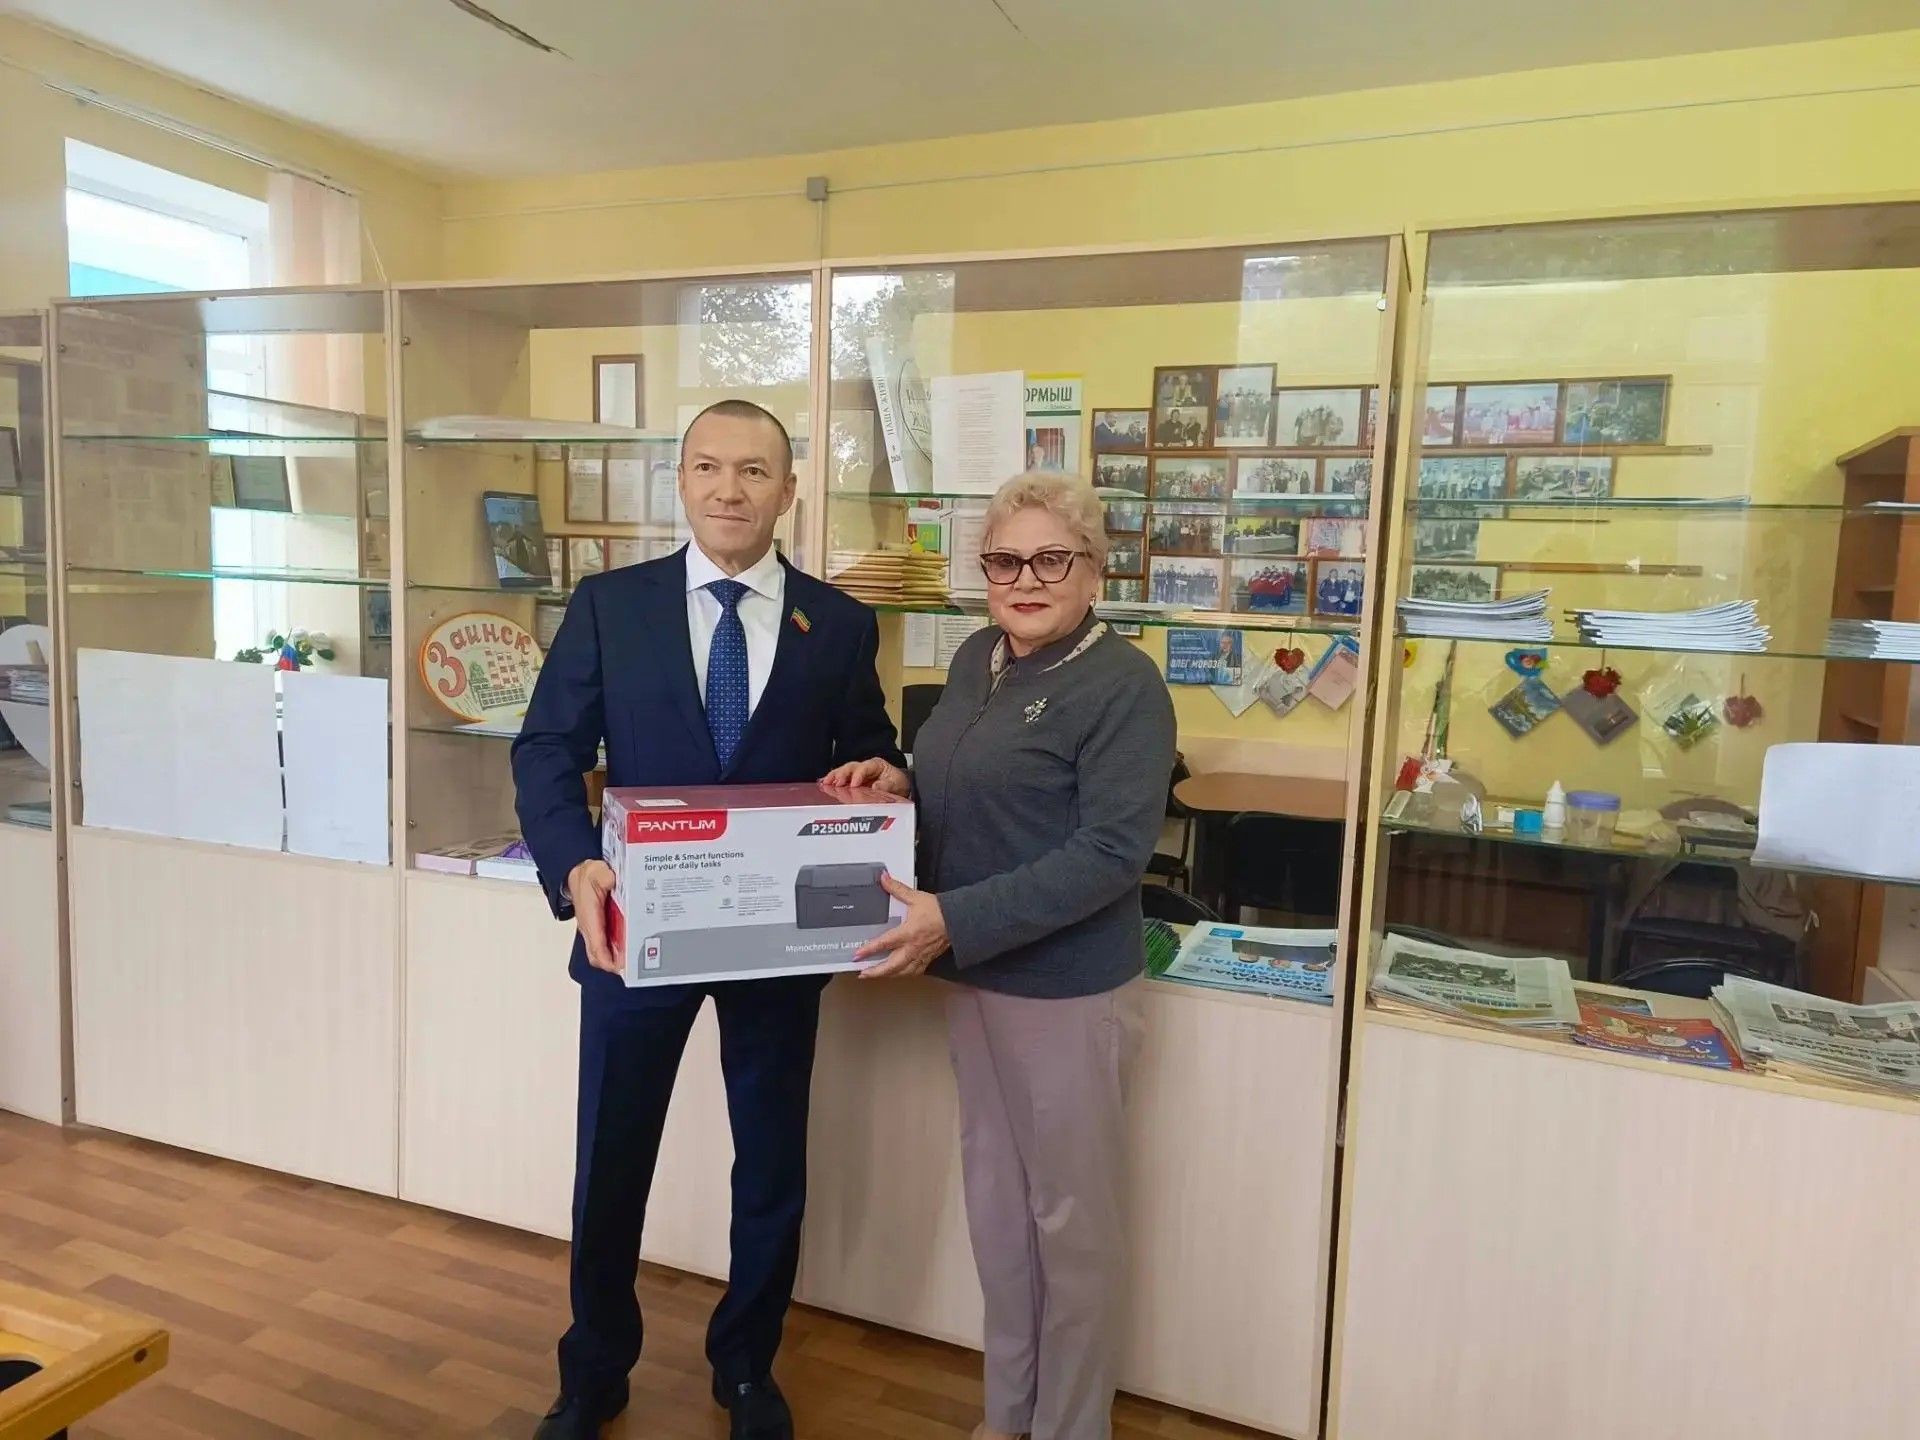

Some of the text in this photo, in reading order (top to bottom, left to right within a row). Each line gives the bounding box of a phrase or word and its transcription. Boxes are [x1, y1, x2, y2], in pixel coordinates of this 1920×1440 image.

[637, 819, 716, 832] PANTUM
[811, 821, 871, 834] P2500NW
[644, 854, 673, 864] Simple
[682, 853, 706, 861] Smart
[708, 850, 745, 860] functions
[644, 860, 721, 872] for your daily tasks
[785, 941, 840, 953] Monochrome
[841, 939, 863, 950] Laser
